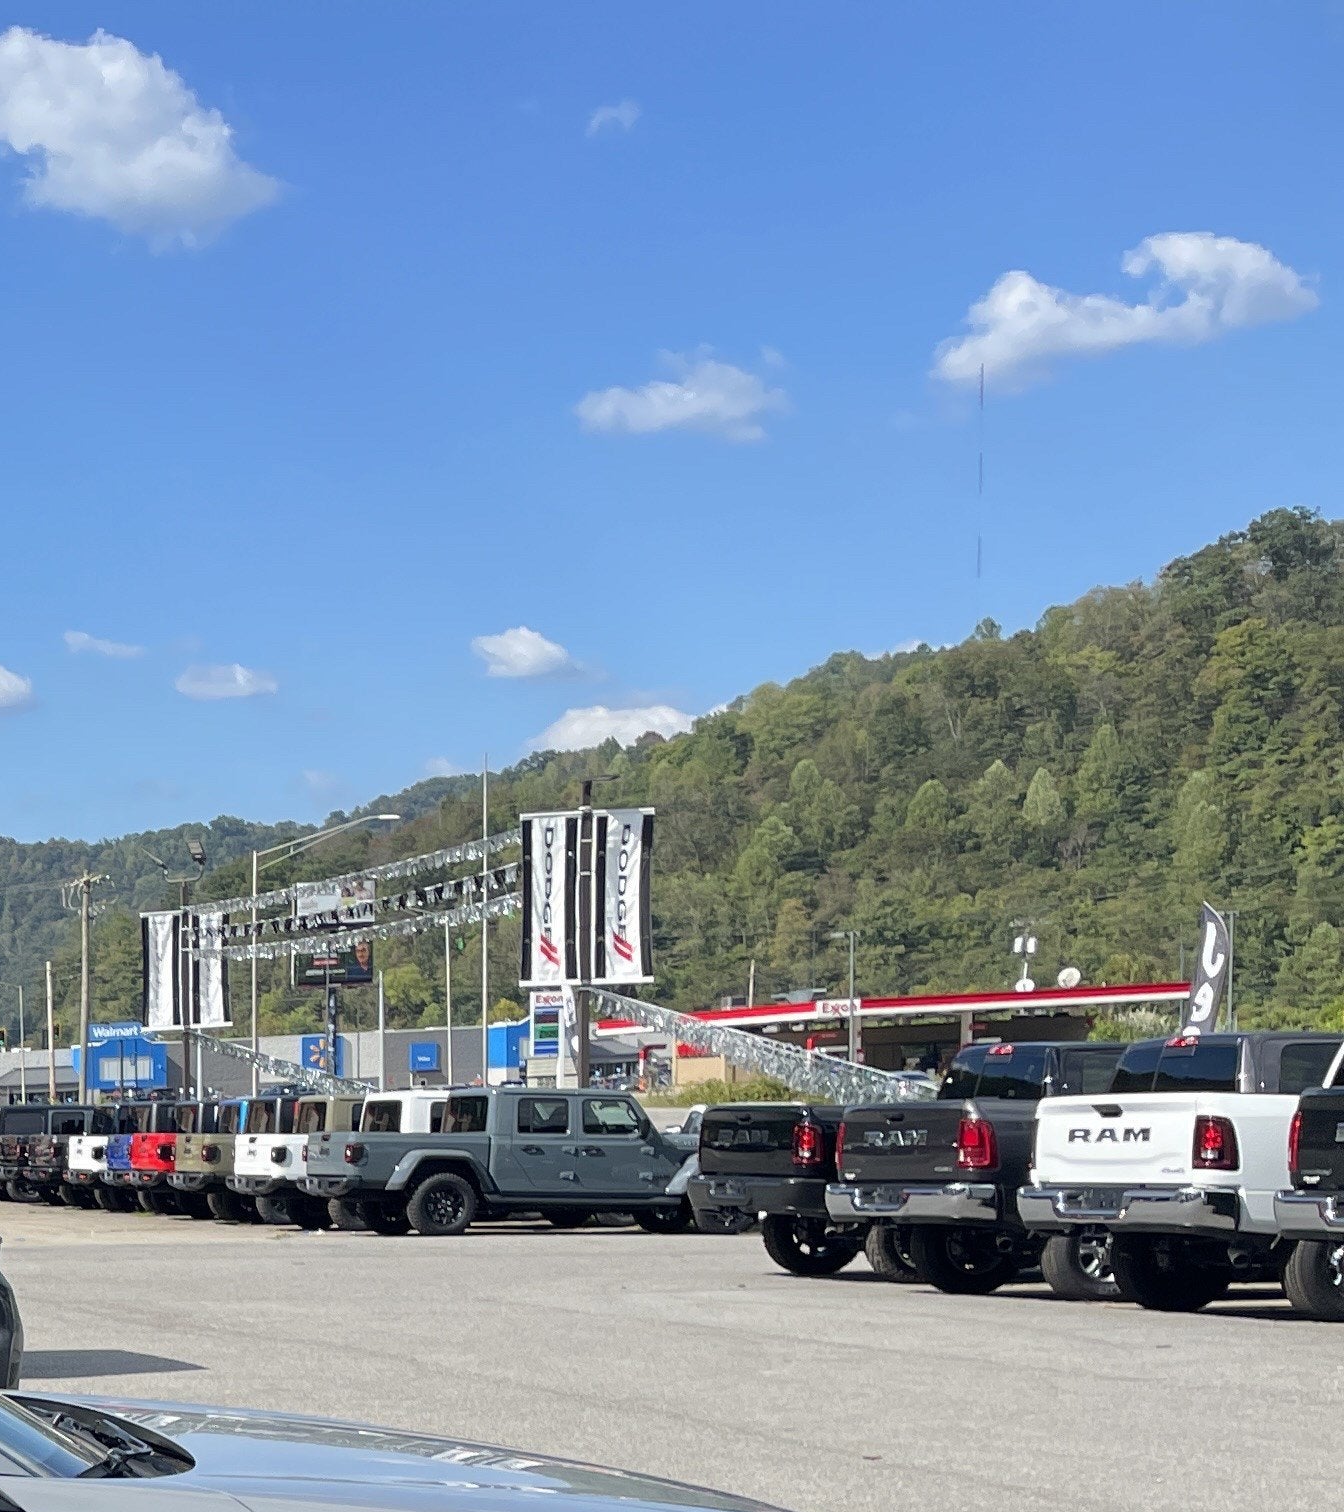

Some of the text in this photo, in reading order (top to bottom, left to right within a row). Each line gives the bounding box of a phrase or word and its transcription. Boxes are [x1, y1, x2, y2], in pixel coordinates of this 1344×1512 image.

[543, 827, 554, 944] DODGE
[617, 824, 631, 941] DODGE
[92, 1025, 138, 1038] Walmart
[864, 1130, 928, 1147] RAM
[1068, 1127, 1151, 1143] RAM
